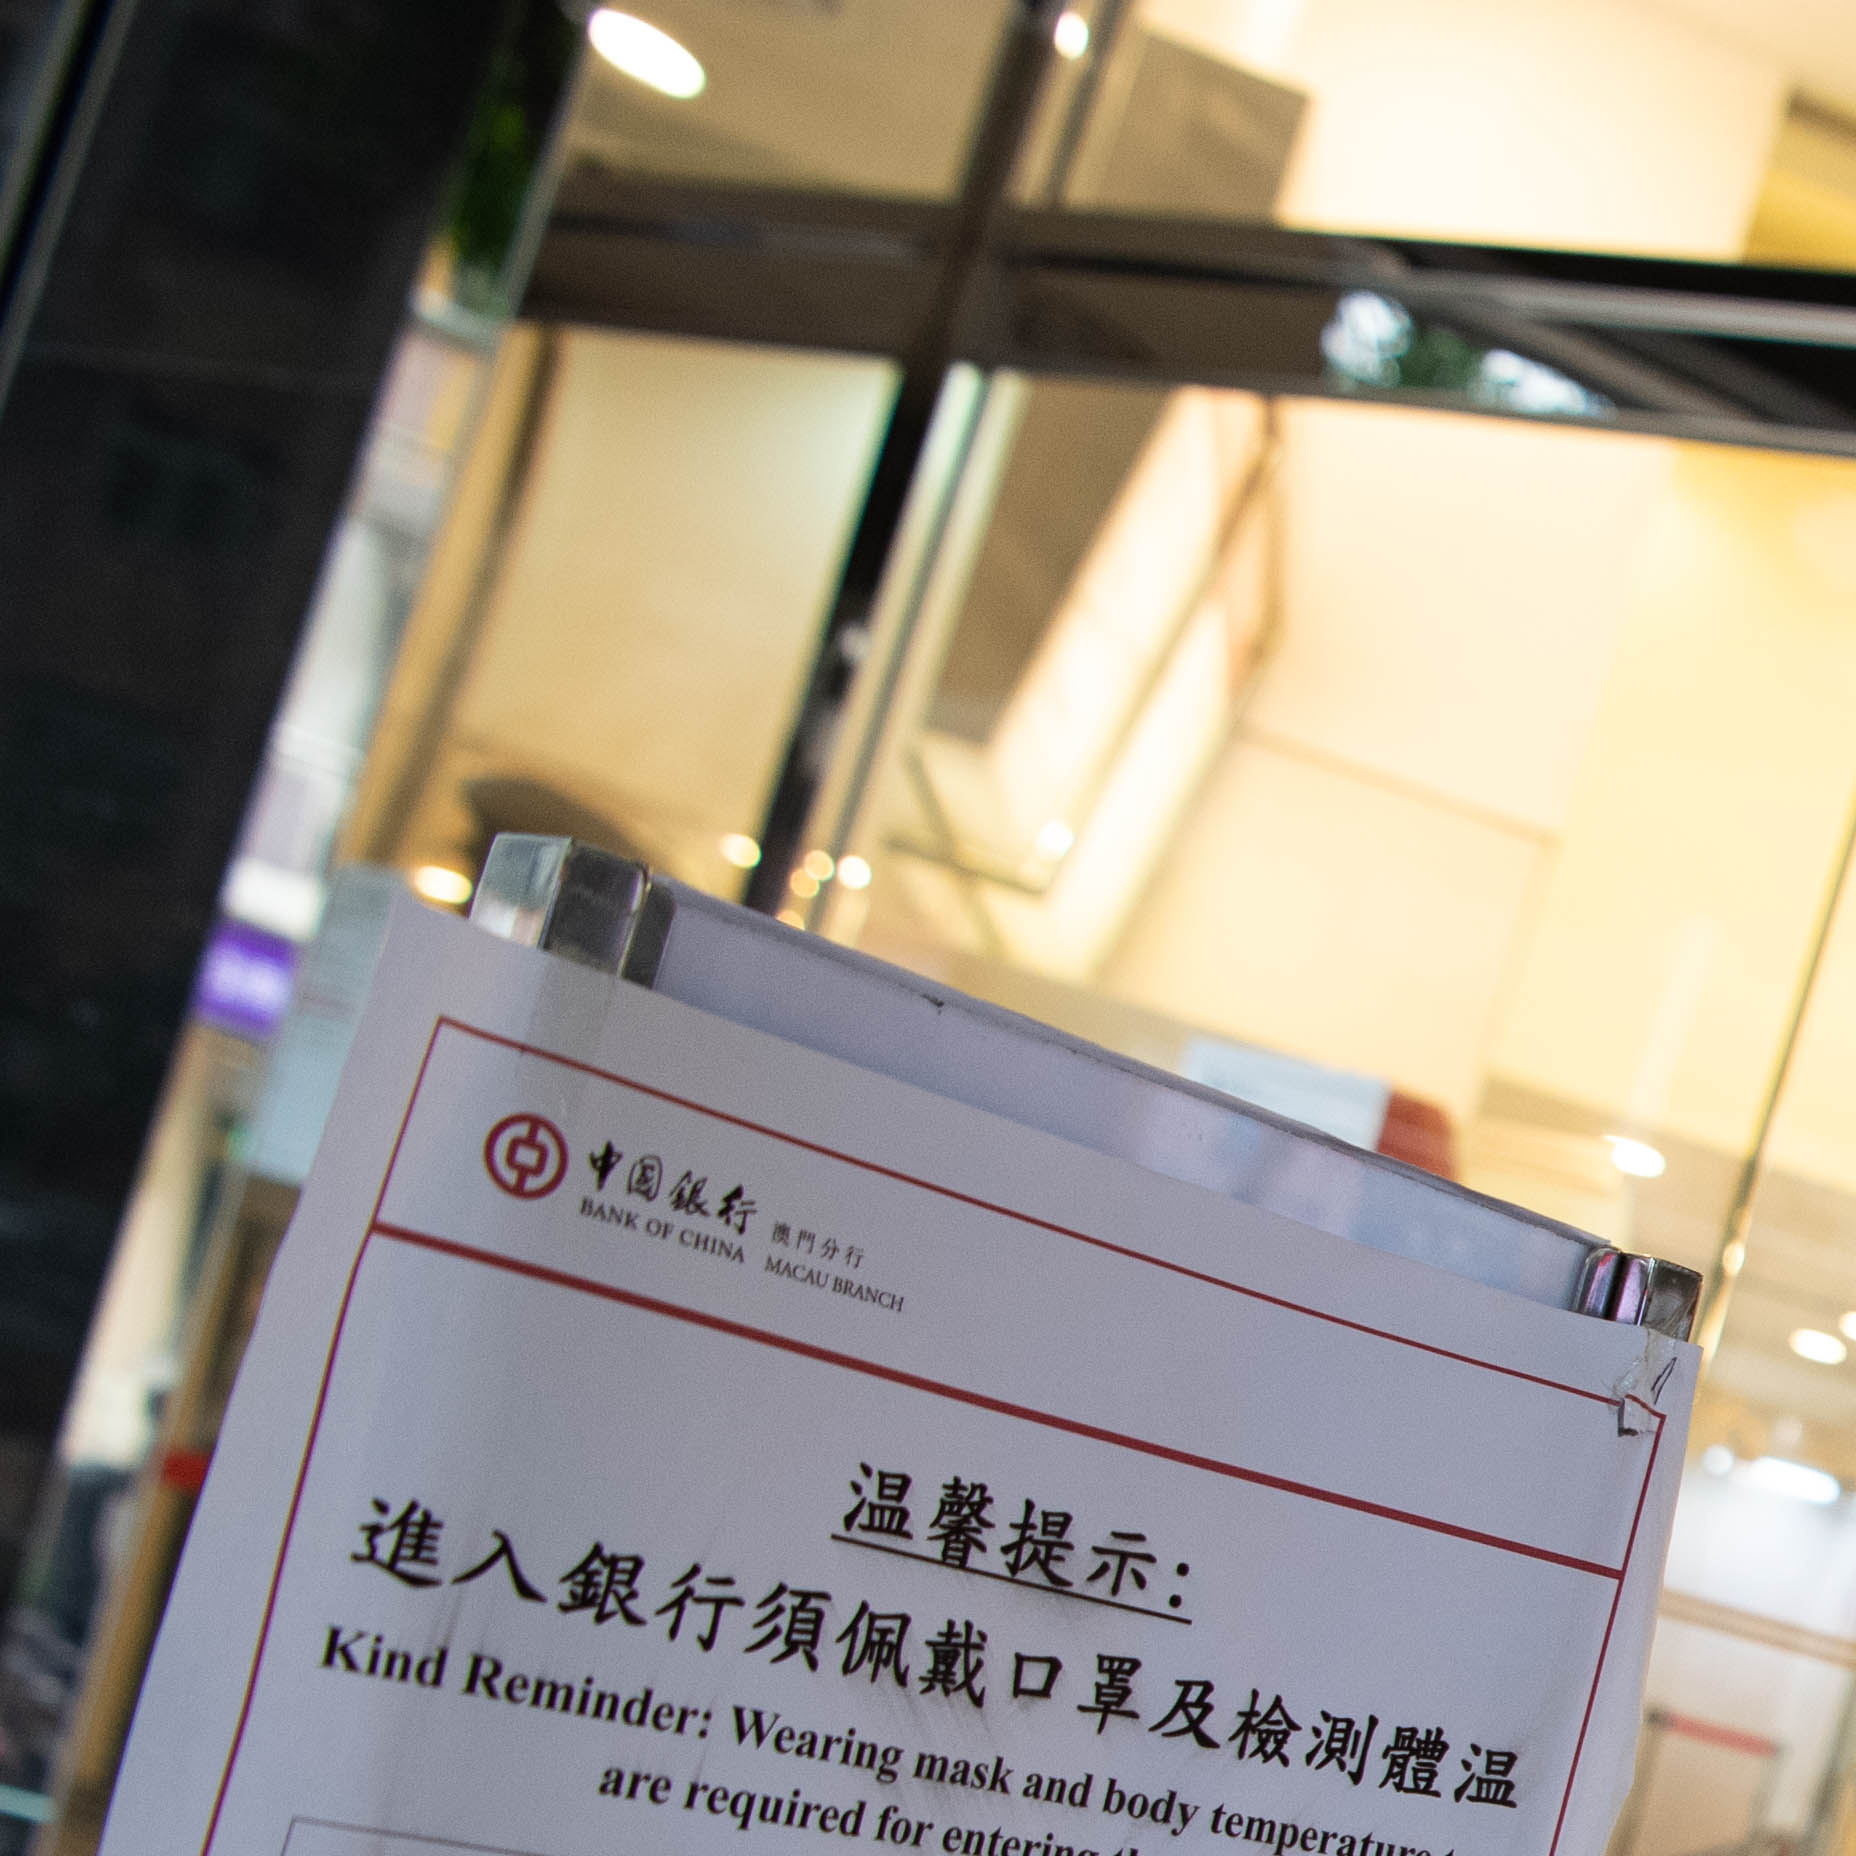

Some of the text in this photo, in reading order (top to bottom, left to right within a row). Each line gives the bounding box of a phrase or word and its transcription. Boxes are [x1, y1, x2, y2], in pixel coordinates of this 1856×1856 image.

[580, 1197, 905, 1313] BANK OF CHINA MACAU BRANCH
[771, 1222, 863, 1269] 澳門分行
[320, 1627, 449, 1688] Kind
[461, 1653, 712, 1739] Reminder:
[733, 1706, 903, 1784] Wearing
[913, 1753, 1012, 1794] mask
[1022, 1773, 1093, 1808] and
[1102, 1778, 1199, 1837] body
[598, 1769, 672, 1804] are
[684, 1781, 867, 1837] required
[875, 1805, 934, 1847] for
